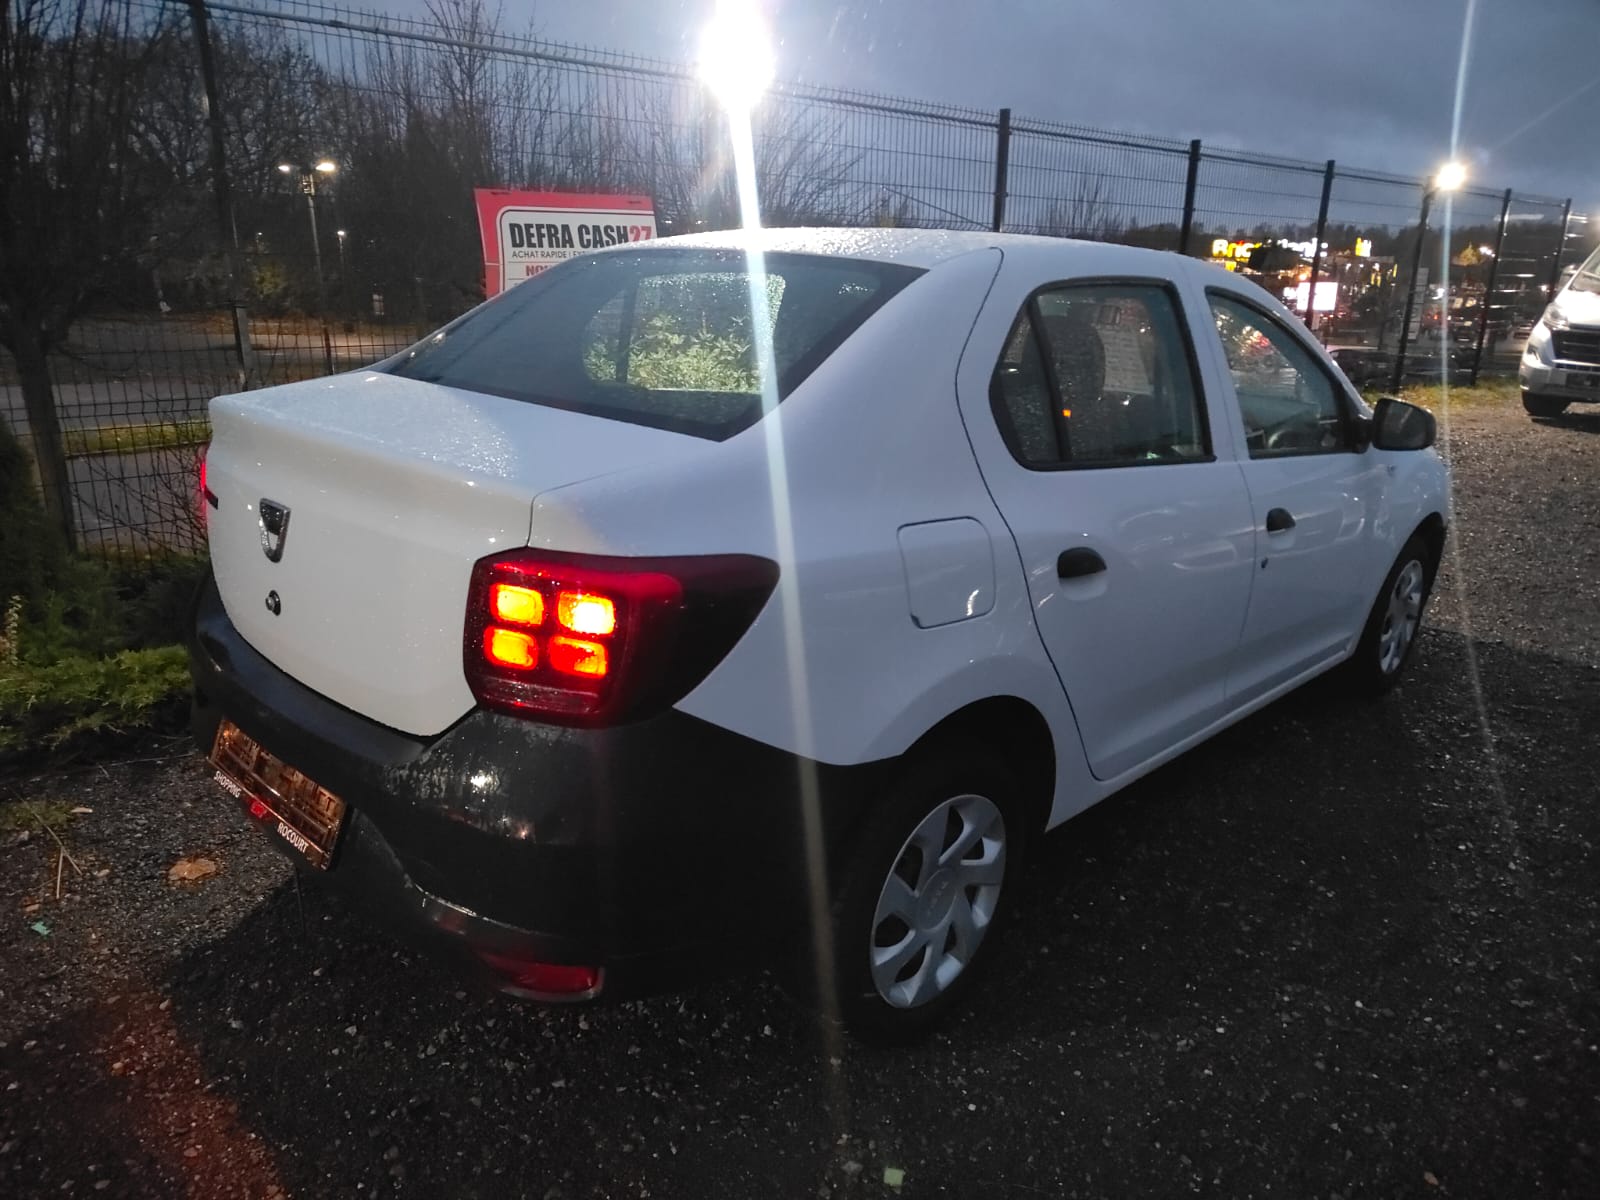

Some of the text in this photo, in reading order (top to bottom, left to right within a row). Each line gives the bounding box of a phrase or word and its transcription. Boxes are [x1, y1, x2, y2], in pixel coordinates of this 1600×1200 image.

[508, 222, 652, 248] DEFRA CASH27
[511, 250, 539, 258] ACHAT
[540, 250, 567, 259] RAPIDE
[213, 770, 241, 798] SHOPPING
[277, 822, 309, 853] ROCOURT
